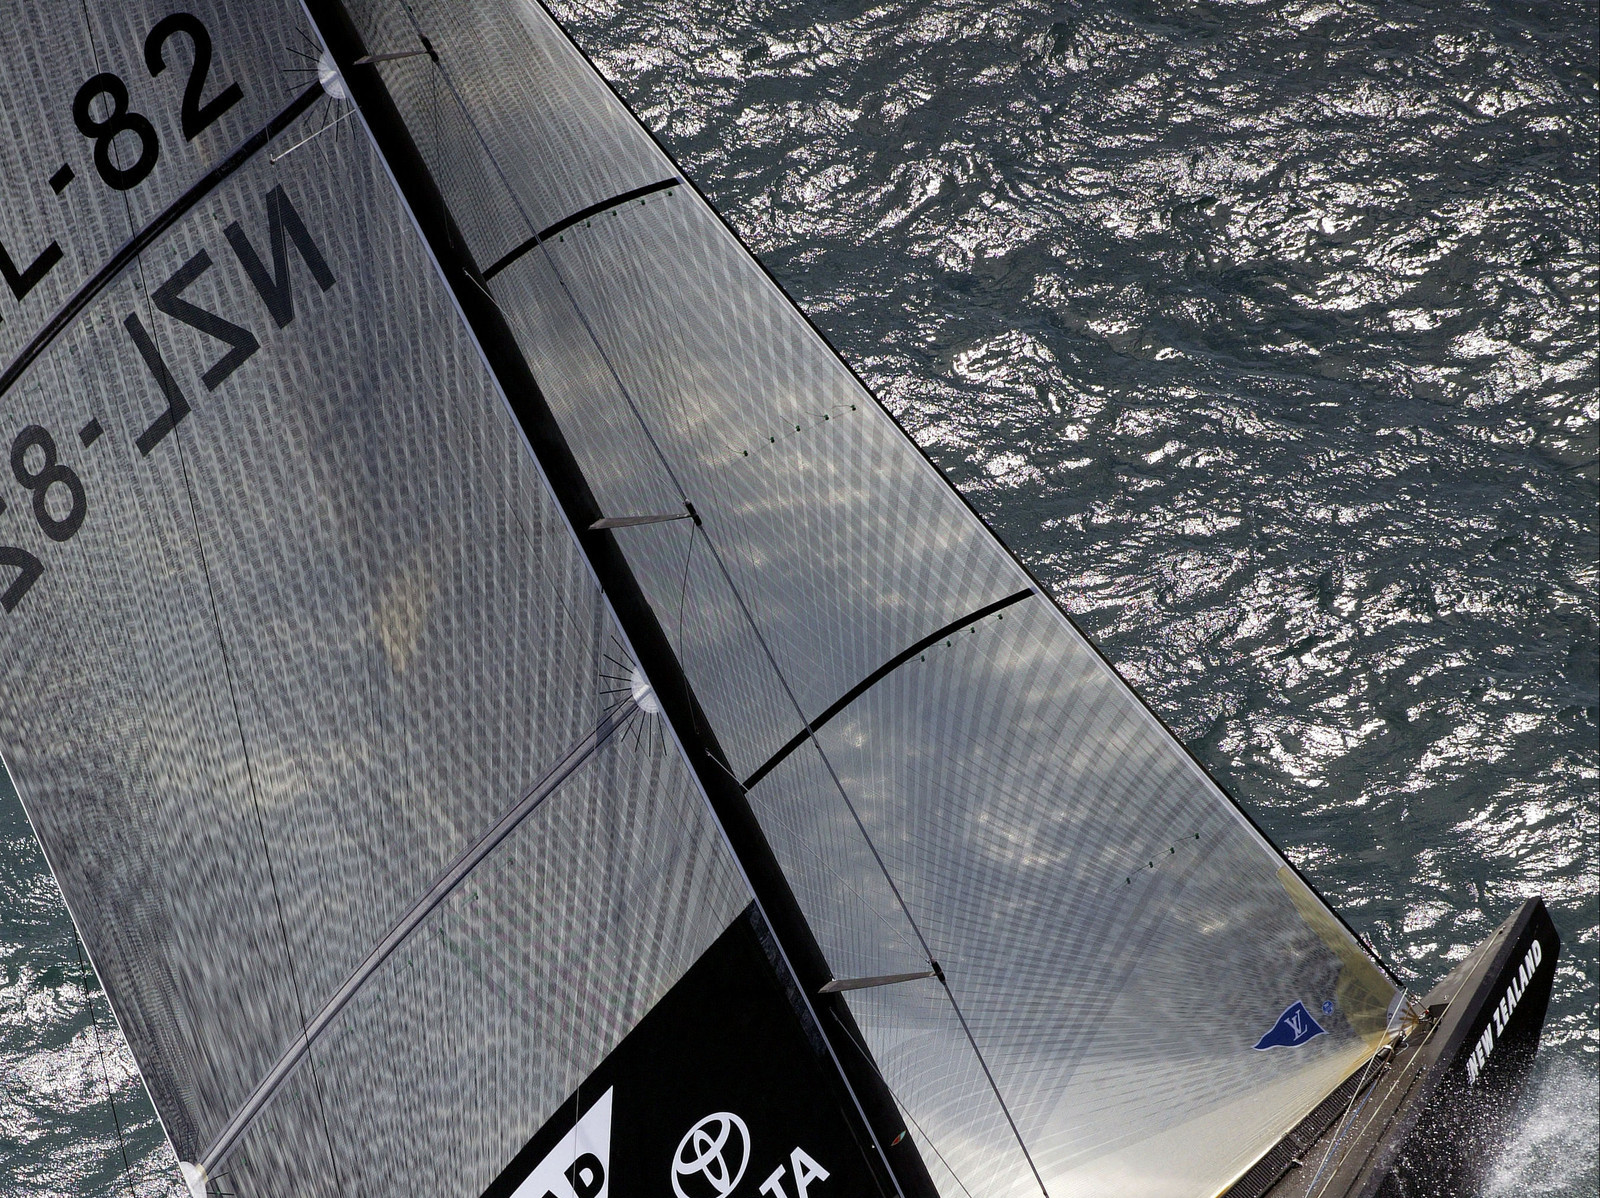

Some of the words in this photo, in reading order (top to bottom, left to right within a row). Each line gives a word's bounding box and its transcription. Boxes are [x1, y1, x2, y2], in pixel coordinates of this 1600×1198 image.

[0, 12, 244, 310] L-82
[1466, 1023, 1494, 1086] NEW
[1493, 939, 1542, 1038] ZEALAND
